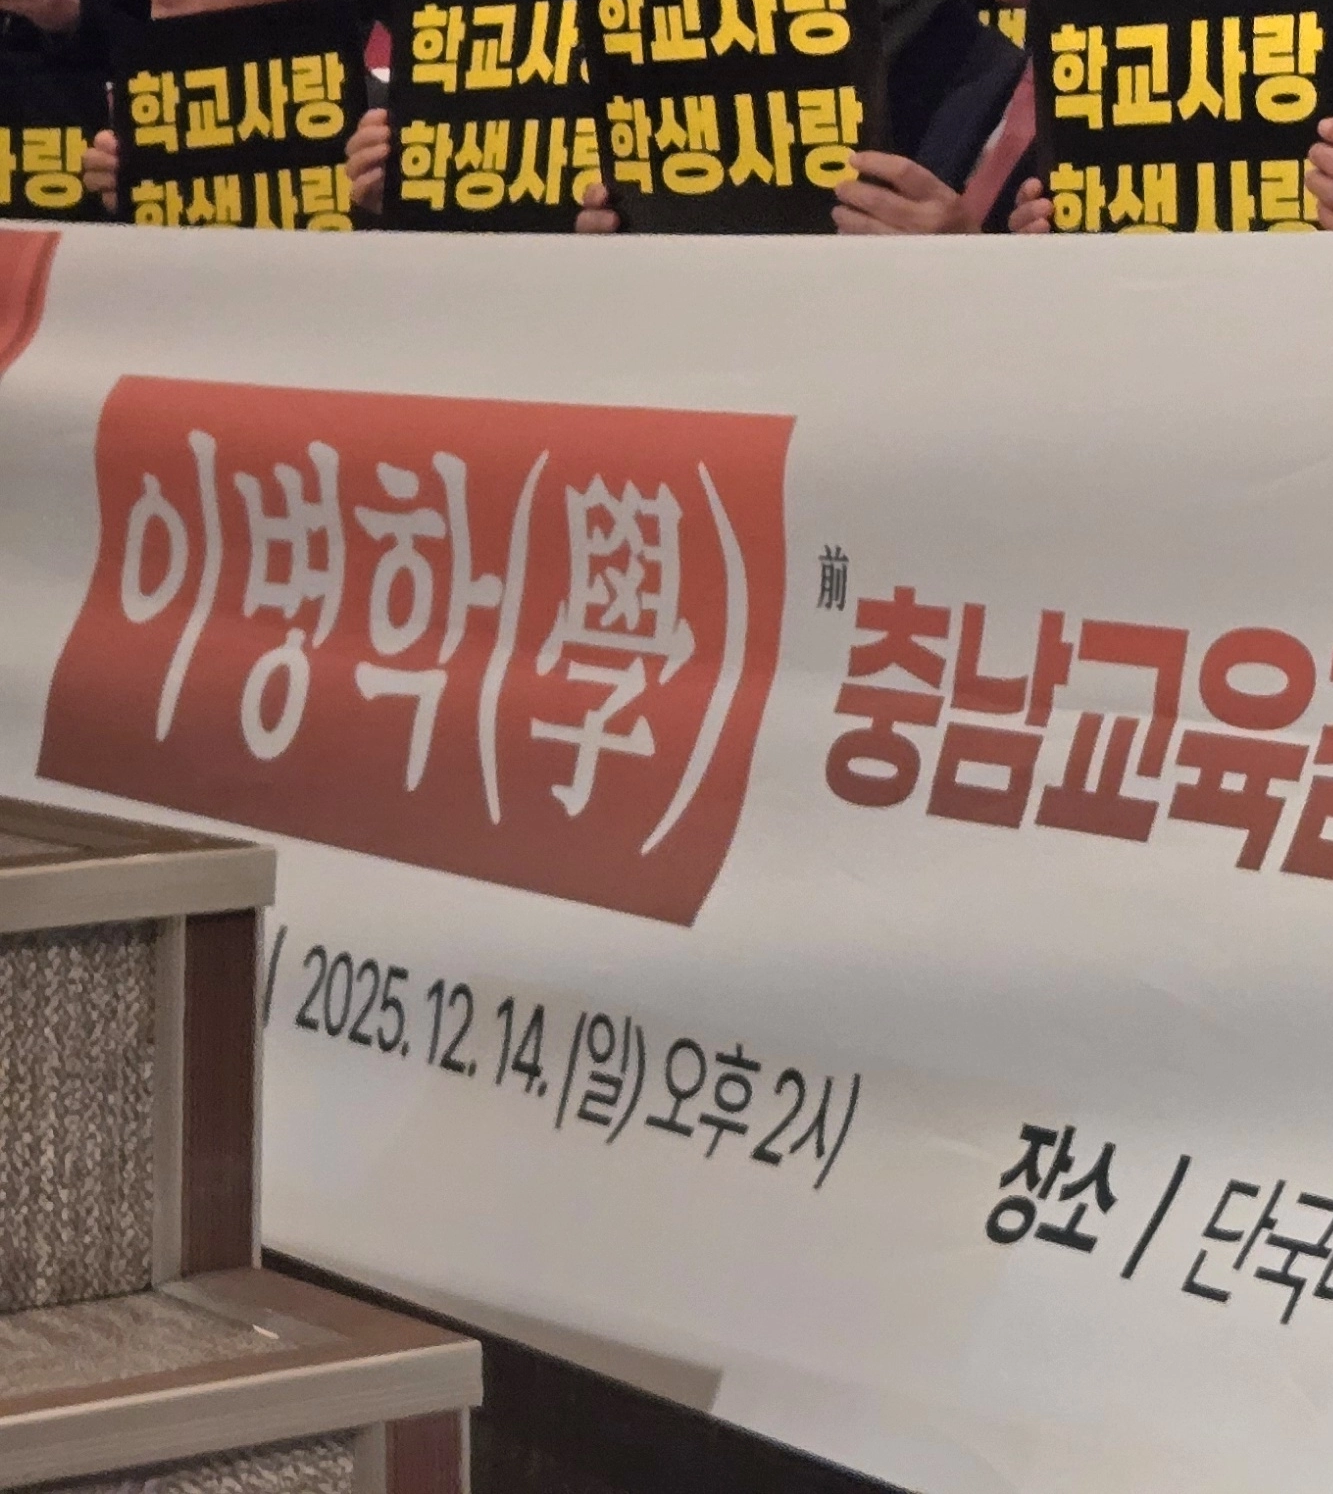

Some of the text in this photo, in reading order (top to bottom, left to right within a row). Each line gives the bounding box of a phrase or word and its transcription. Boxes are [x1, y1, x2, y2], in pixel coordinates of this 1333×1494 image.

[127, 53, 346, 154] 학교사랑
[1050, 11, 1324, 129] 학교사랑
[606, 84, 864, 196] 학생사랑
[817, 543, 850, 612] 前
[119, 429, 748, 856] 이병학(學)
[984, 1122, 1119, 1253] 장소
